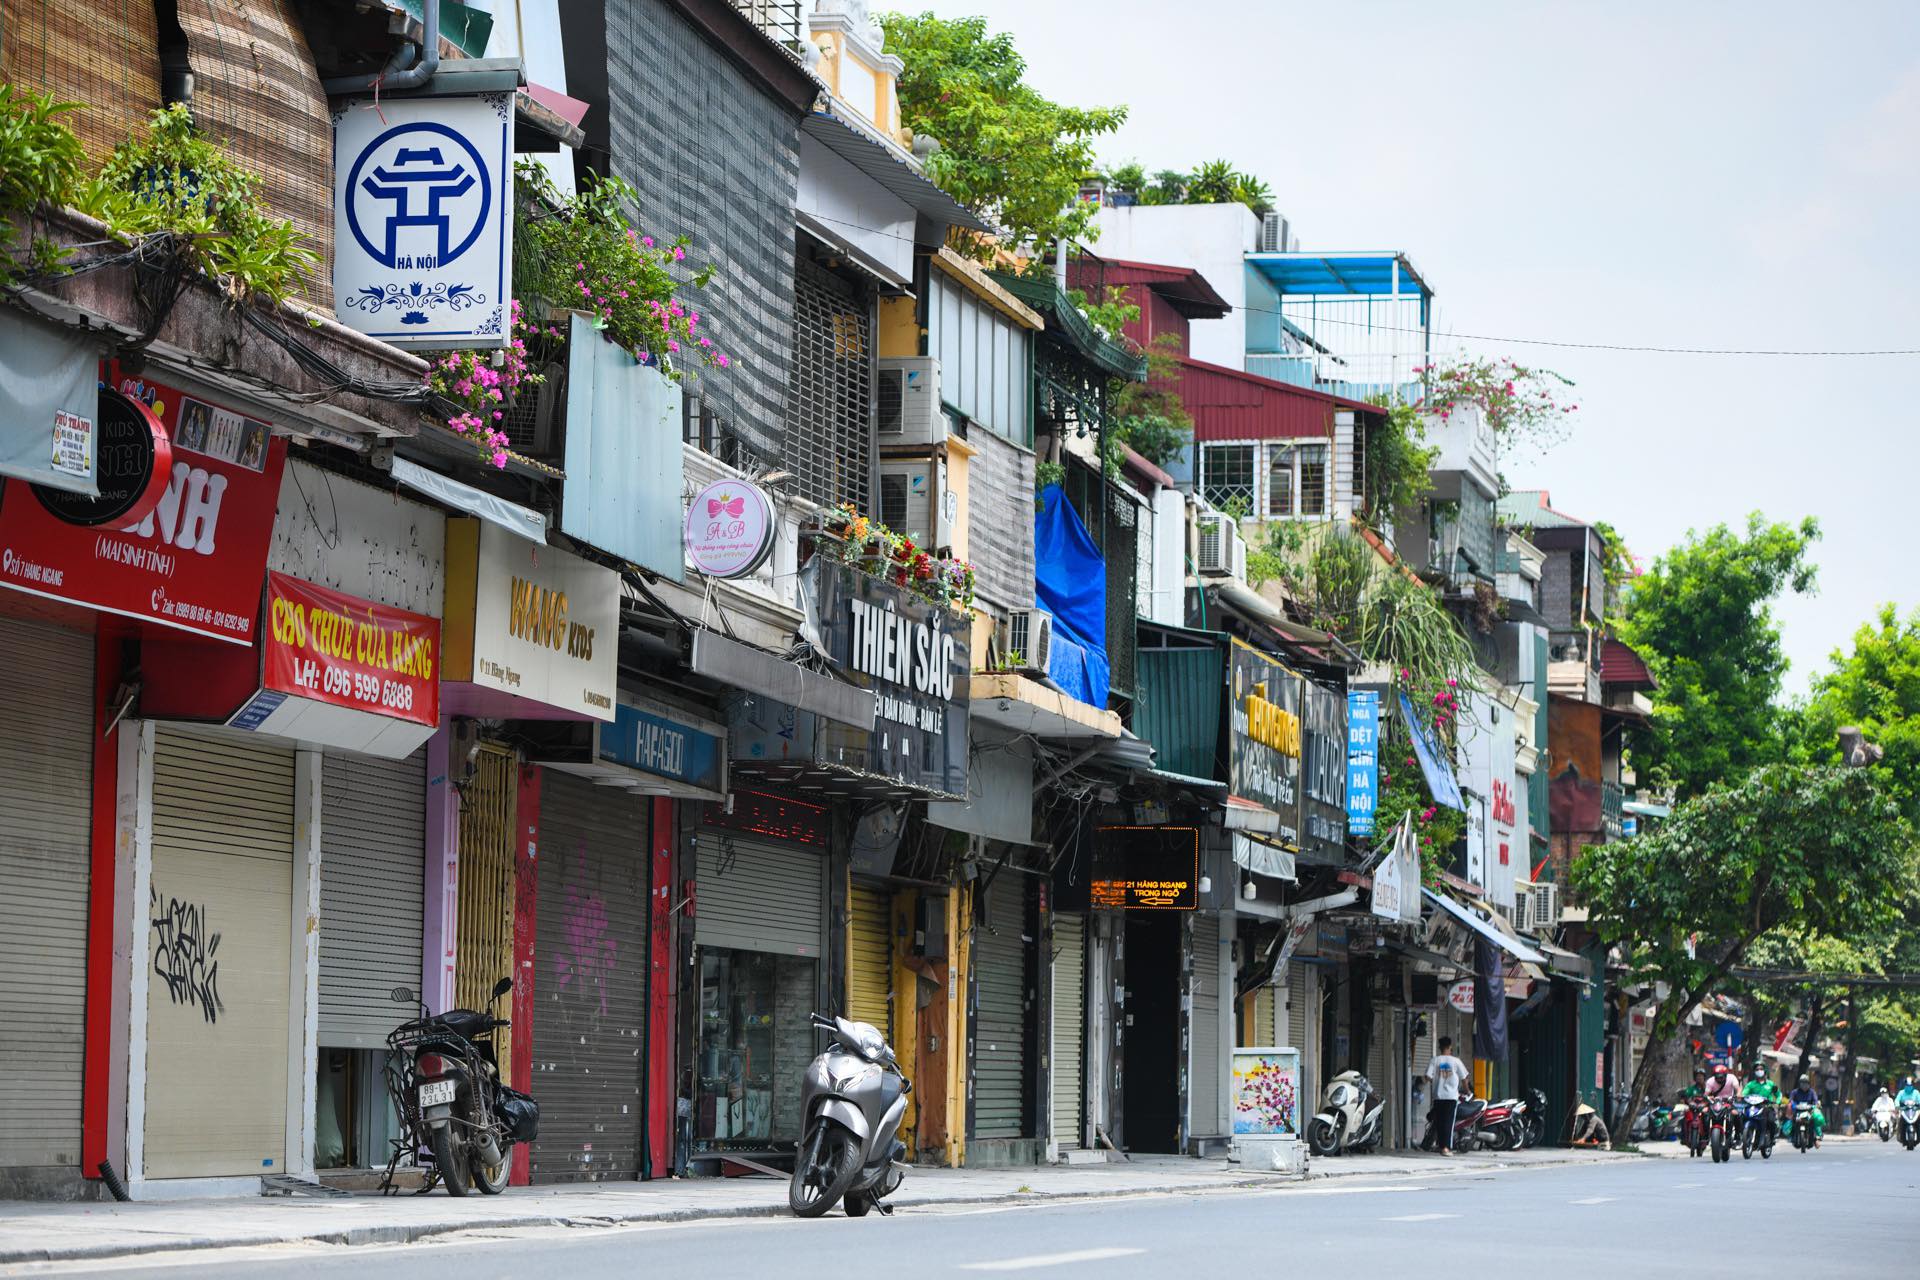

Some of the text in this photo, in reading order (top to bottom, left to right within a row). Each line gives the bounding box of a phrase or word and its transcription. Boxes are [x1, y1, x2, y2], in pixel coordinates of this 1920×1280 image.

[397, 253, 437, 272] HÀ NỘI
[105, 421, 135, 438] KIDS
[97, 443, 143, 477] NH
[120, 461, 228, 555] NH
[121, 543, 146, 568] SINH
[41, 566, 64, 586] NGANG
[271, 596, 432, 680] CHO THUÊ CỬA HÀNG
[567, 620, 595, 661] KIDS
[851, 598, 954, 701] THIÊN SẮC
[294, 657, 413, 711] LH: 096 599 6888
[884, 693, 899, 722] BÁN
[920, 705, 935, 733] BÁN
[1350, 725, 1373, 746] DỆT
[1353, 770, 1370, 789] HÀ
[1350, 793, 1372, 813] NỘI
[1126, 880, 1188, 889] 21 HÀNG NGANG
[1134, 889, 1161, 897] TRONG
[421, 1089, 453, 1107] 234.31
[423, 1082, 449, 1095] 89-L1
